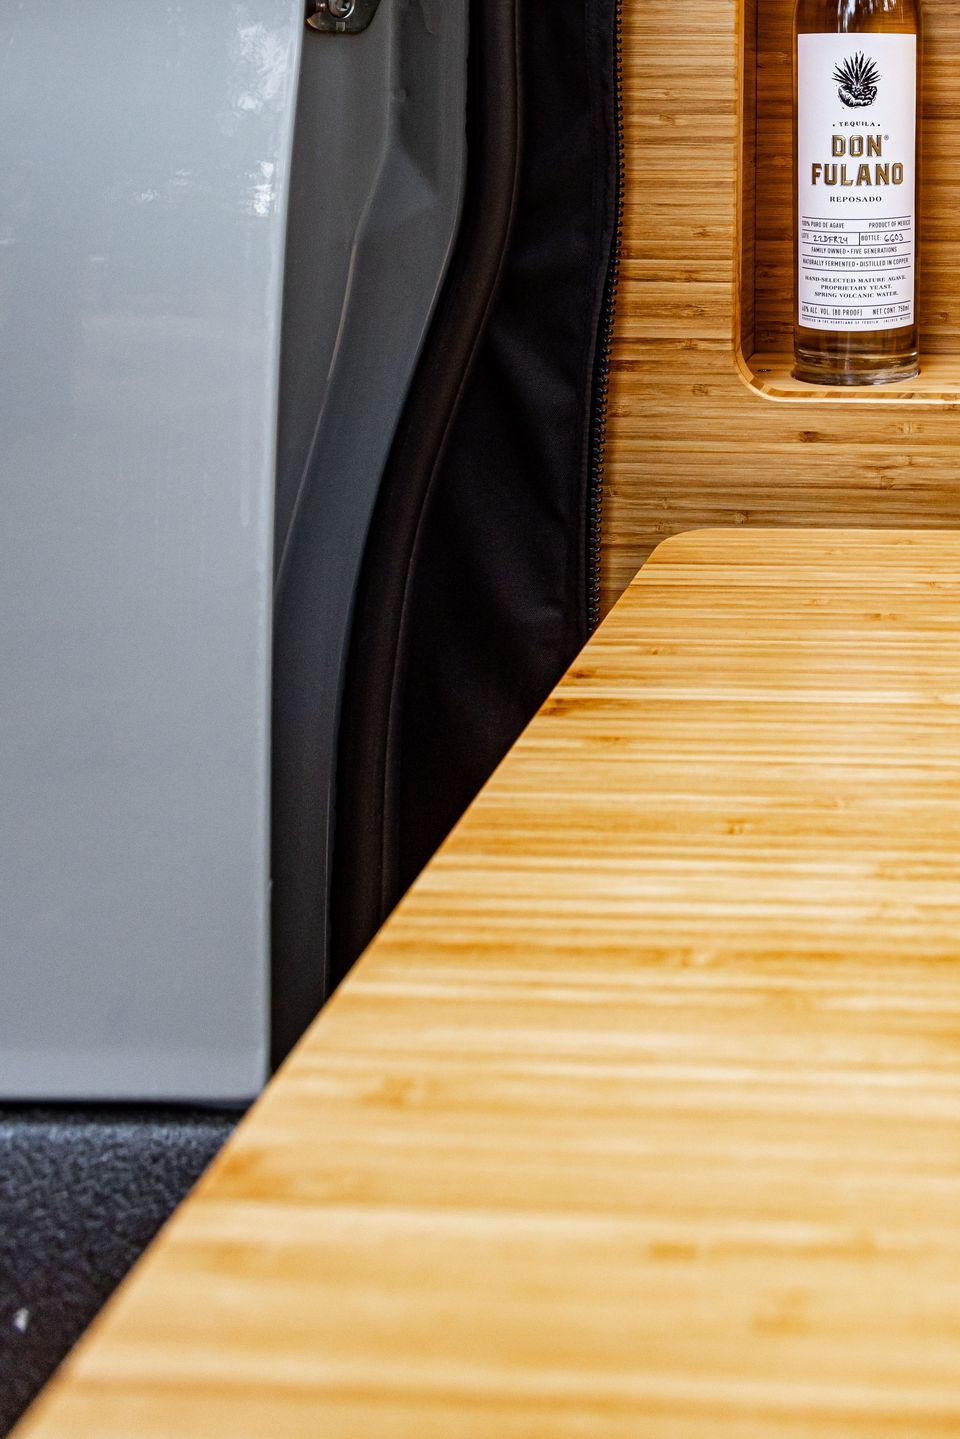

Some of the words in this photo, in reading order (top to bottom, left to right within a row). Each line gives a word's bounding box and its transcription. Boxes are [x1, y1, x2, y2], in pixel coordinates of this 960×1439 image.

[832, 135, 882, 156] DON
[811, 163, 904, 186] FULANO
[884, 234, 904, 242] 6603
[864, 246, 897, 254] GENERATIONS
